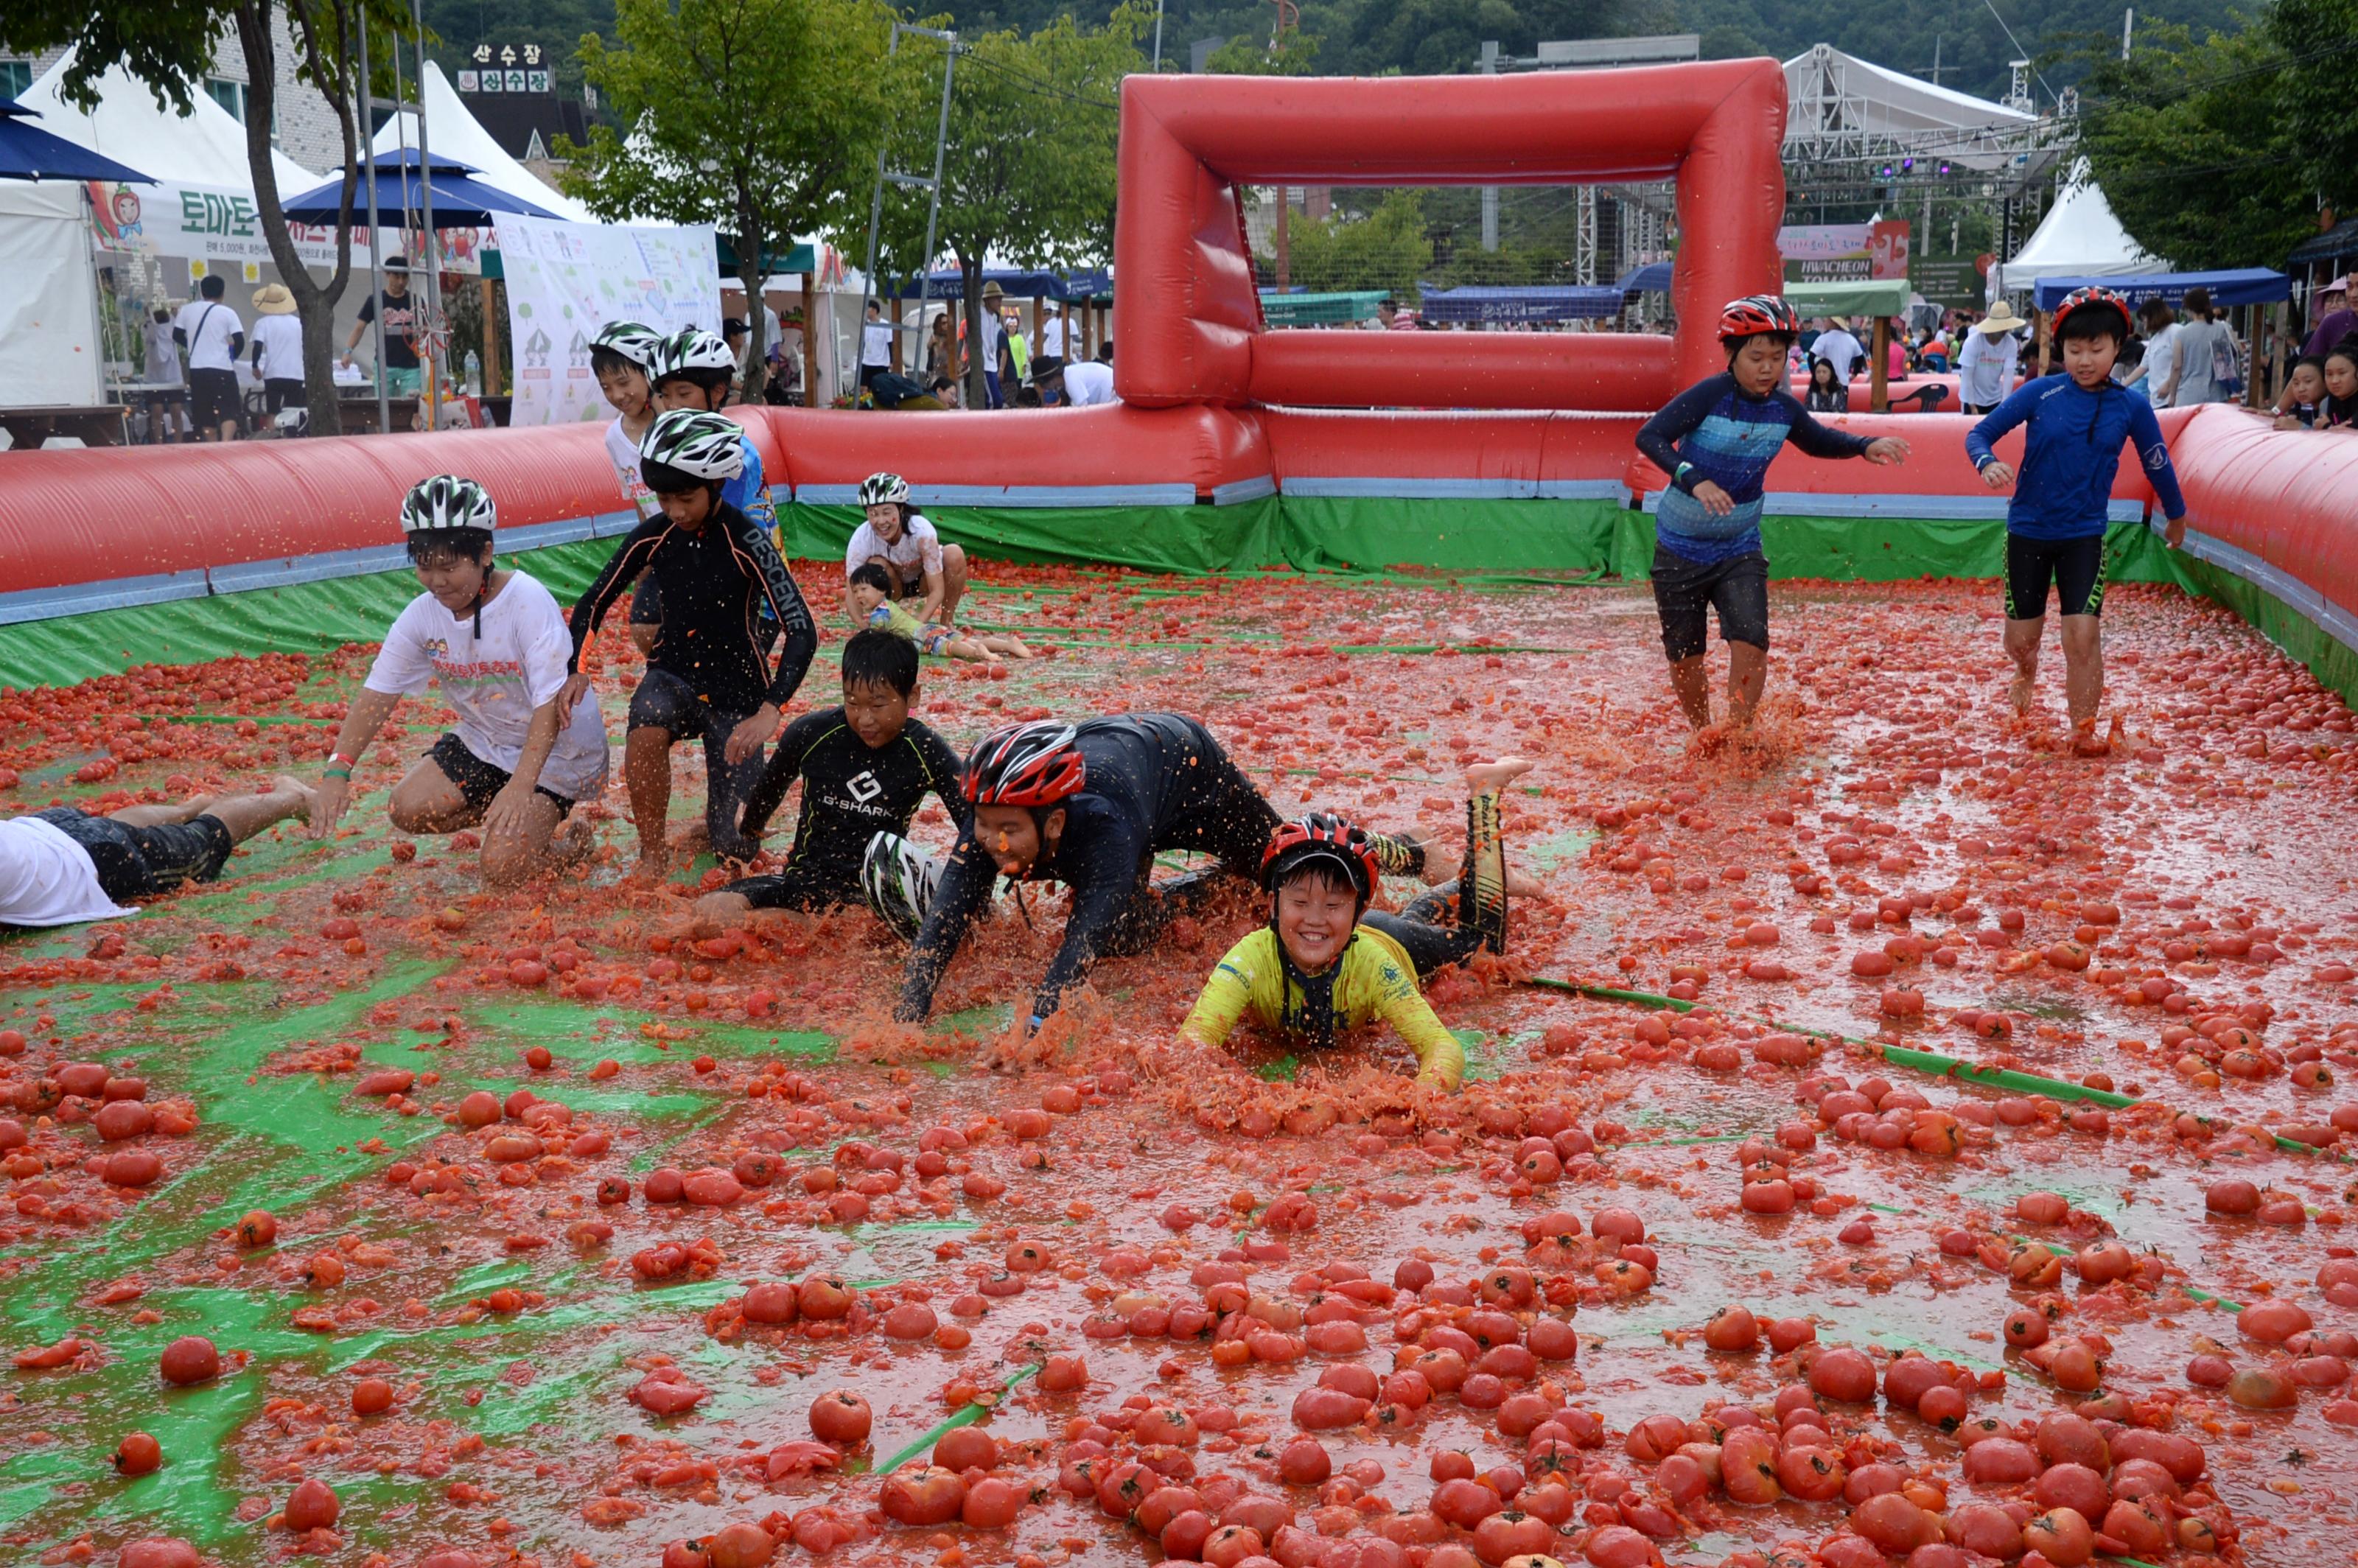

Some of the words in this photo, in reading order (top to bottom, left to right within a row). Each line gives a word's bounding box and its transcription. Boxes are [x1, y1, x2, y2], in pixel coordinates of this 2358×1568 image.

[472, 44, 542, 67] 산수장
[483, 72, 547, 91] 산수장
[179, 190, 256, 237] 토마토
[1801, 260, 1870, 273] HWACHEON
[742, 528, 808, 631] DESCENTE
